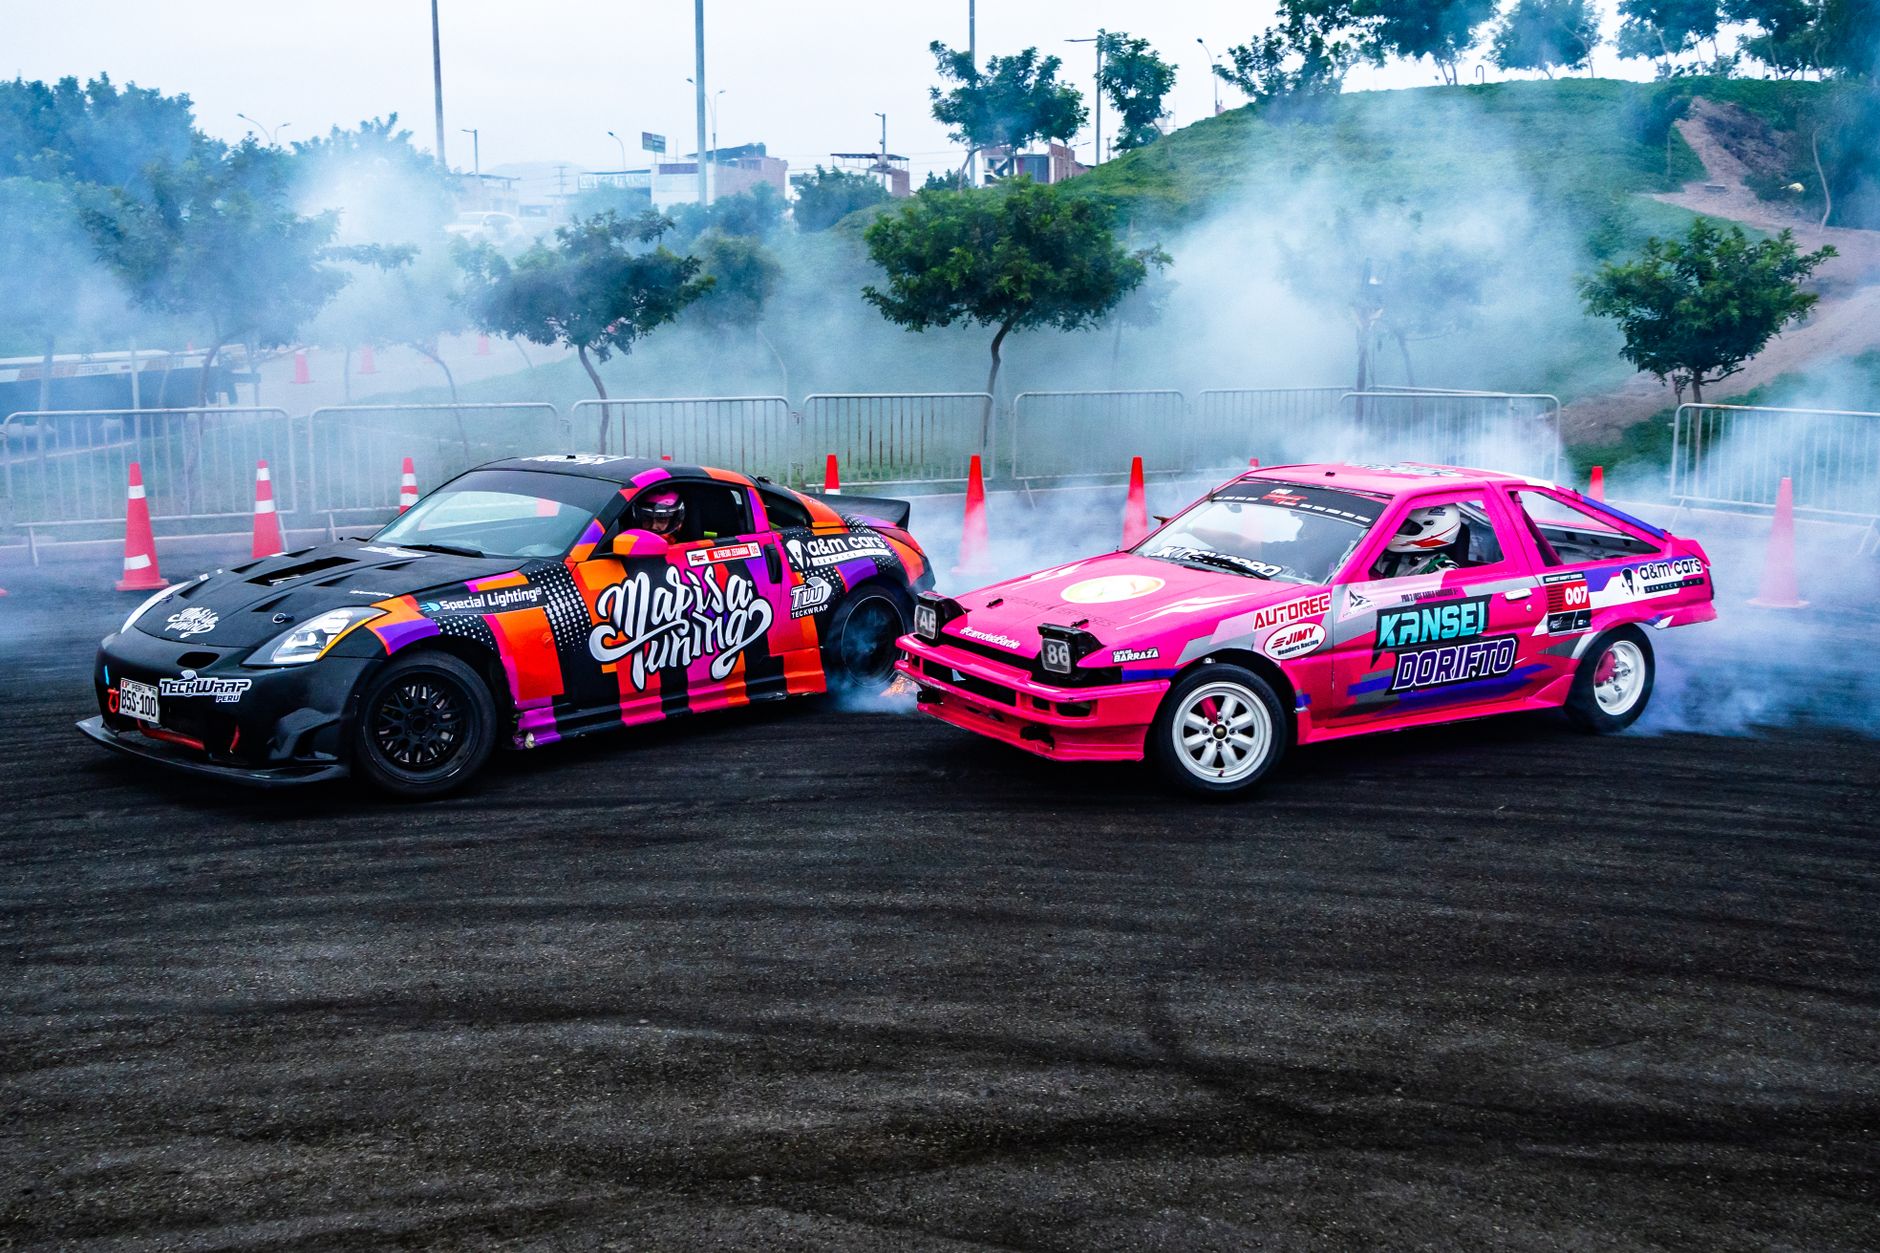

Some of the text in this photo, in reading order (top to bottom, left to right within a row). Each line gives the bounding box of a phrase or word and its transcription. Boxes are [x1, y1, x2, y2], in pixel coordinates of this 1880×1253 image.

[807, 536, 886, 556] a&m cars
[1640, 559, 1701, 580] a&m cars
[440, 595, 485, 611] Special
[1565, 585, 1588, 605] 007
[791, 604, 829, 619] TECKWRAP
[1254, 594, 1330, 630] AUTOREC
[1378, 601, 1486, 648] KANSEI
[1285, 626, 1316, 646] JIMY
[1048, 644, 1070, 666] 86
[1113, 650, 1159, 663] BARRAZA
[1392, 637, 1517, 691] DORIFTO
[121, 688, 157, 717] B5S-100
[216, 695, 239, 703] PERU
